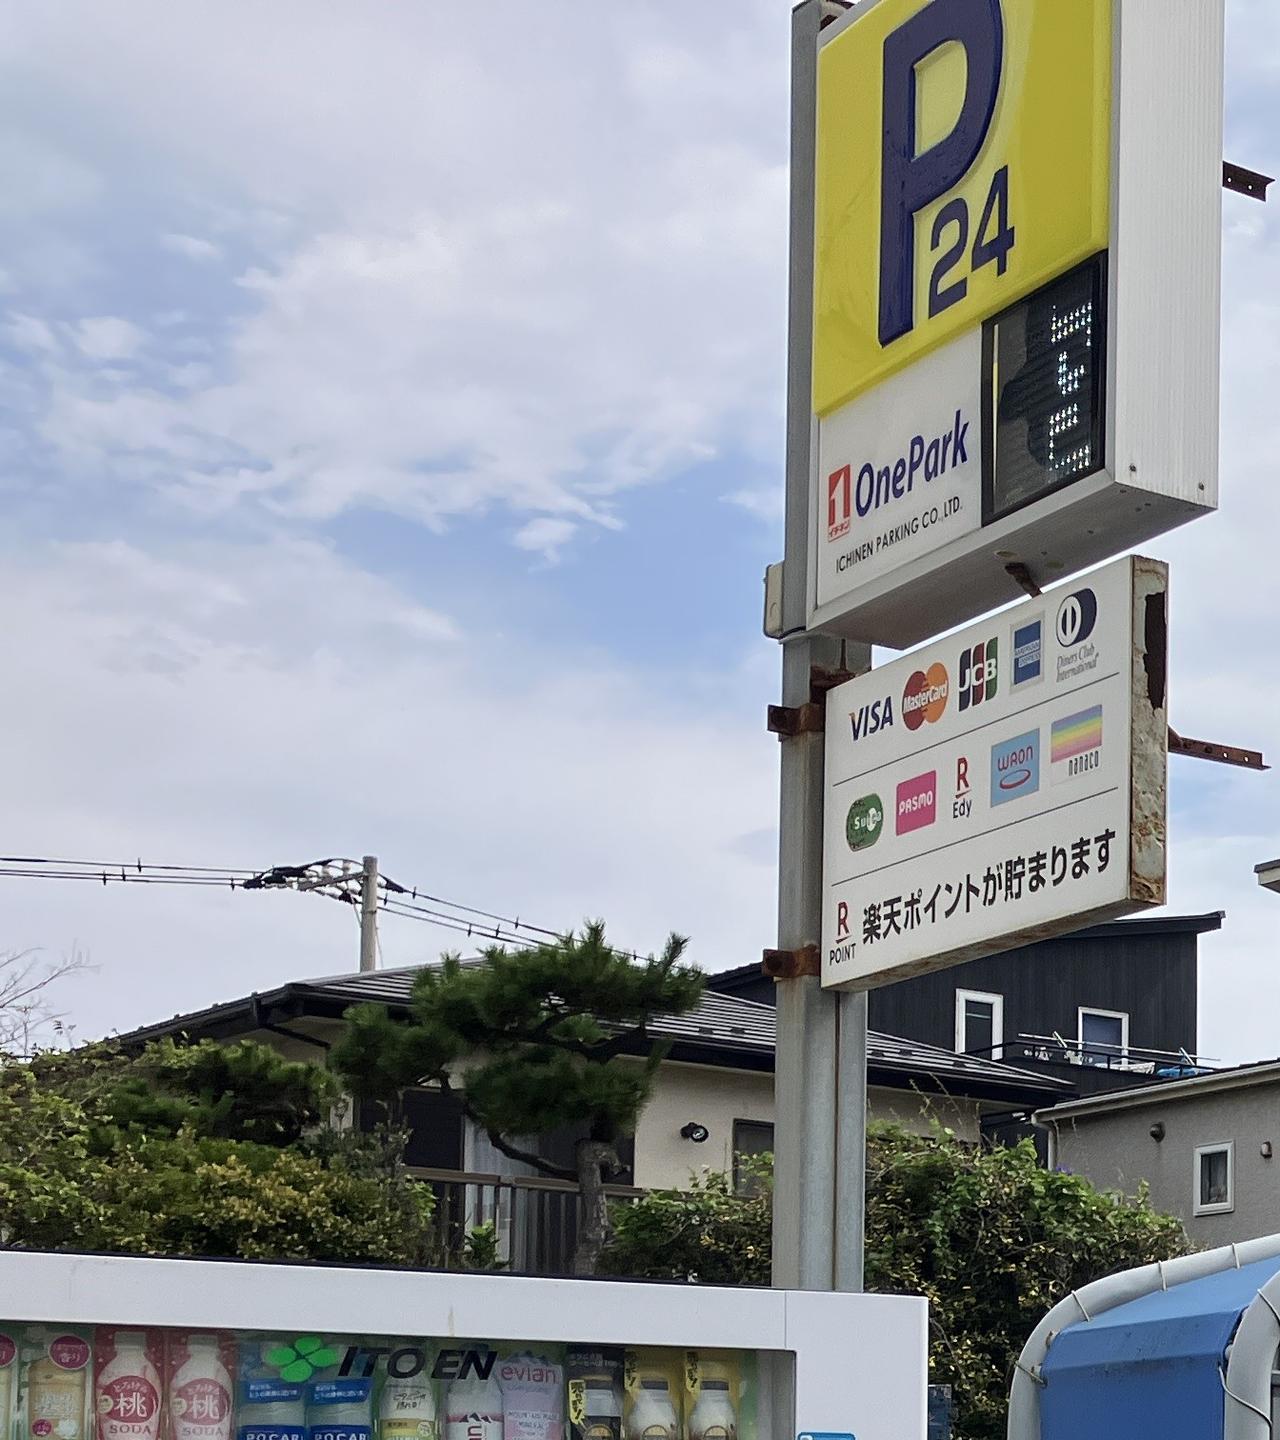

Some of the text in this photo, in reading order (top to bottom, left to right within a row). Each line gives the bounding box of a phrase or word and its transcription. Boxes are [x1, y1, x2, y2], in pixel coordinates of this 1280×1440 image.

[878, 0, 1003, 347] P
[928, 164, 1015, 320] 24
[855, 409, 969, 518] OnePark
[836, 541, 874, 574] ICHINEN
[876, 517, 919, 553] PARKING
[1079, 643, 1095, 661] Club
[959, 657, 998, 692] JCB
[902, 679, 949, 714] MasterCard
[849, 696, 893, 741] VISA
[997, 744, 1034, 772] WAON
[1068, 749, 1100, 777] nanaco
[899, 790, 934, 816] PASMO
[952, 798, 972, 819] Edy
[862, 827, 1118, 945] 楽天ポイントが貯まります
[829, 941, 857, 966] POINT
[338, 1346, 498, 1381] ITO EN
[502, 1365, 557, 1384] evian
[114, 1391, 148, 1417] 桃
[190, 1394, 220, 1419] 桃
[109, 1424, 152, 1434] SODA
[182, 1426, 224, 1436] SODA
